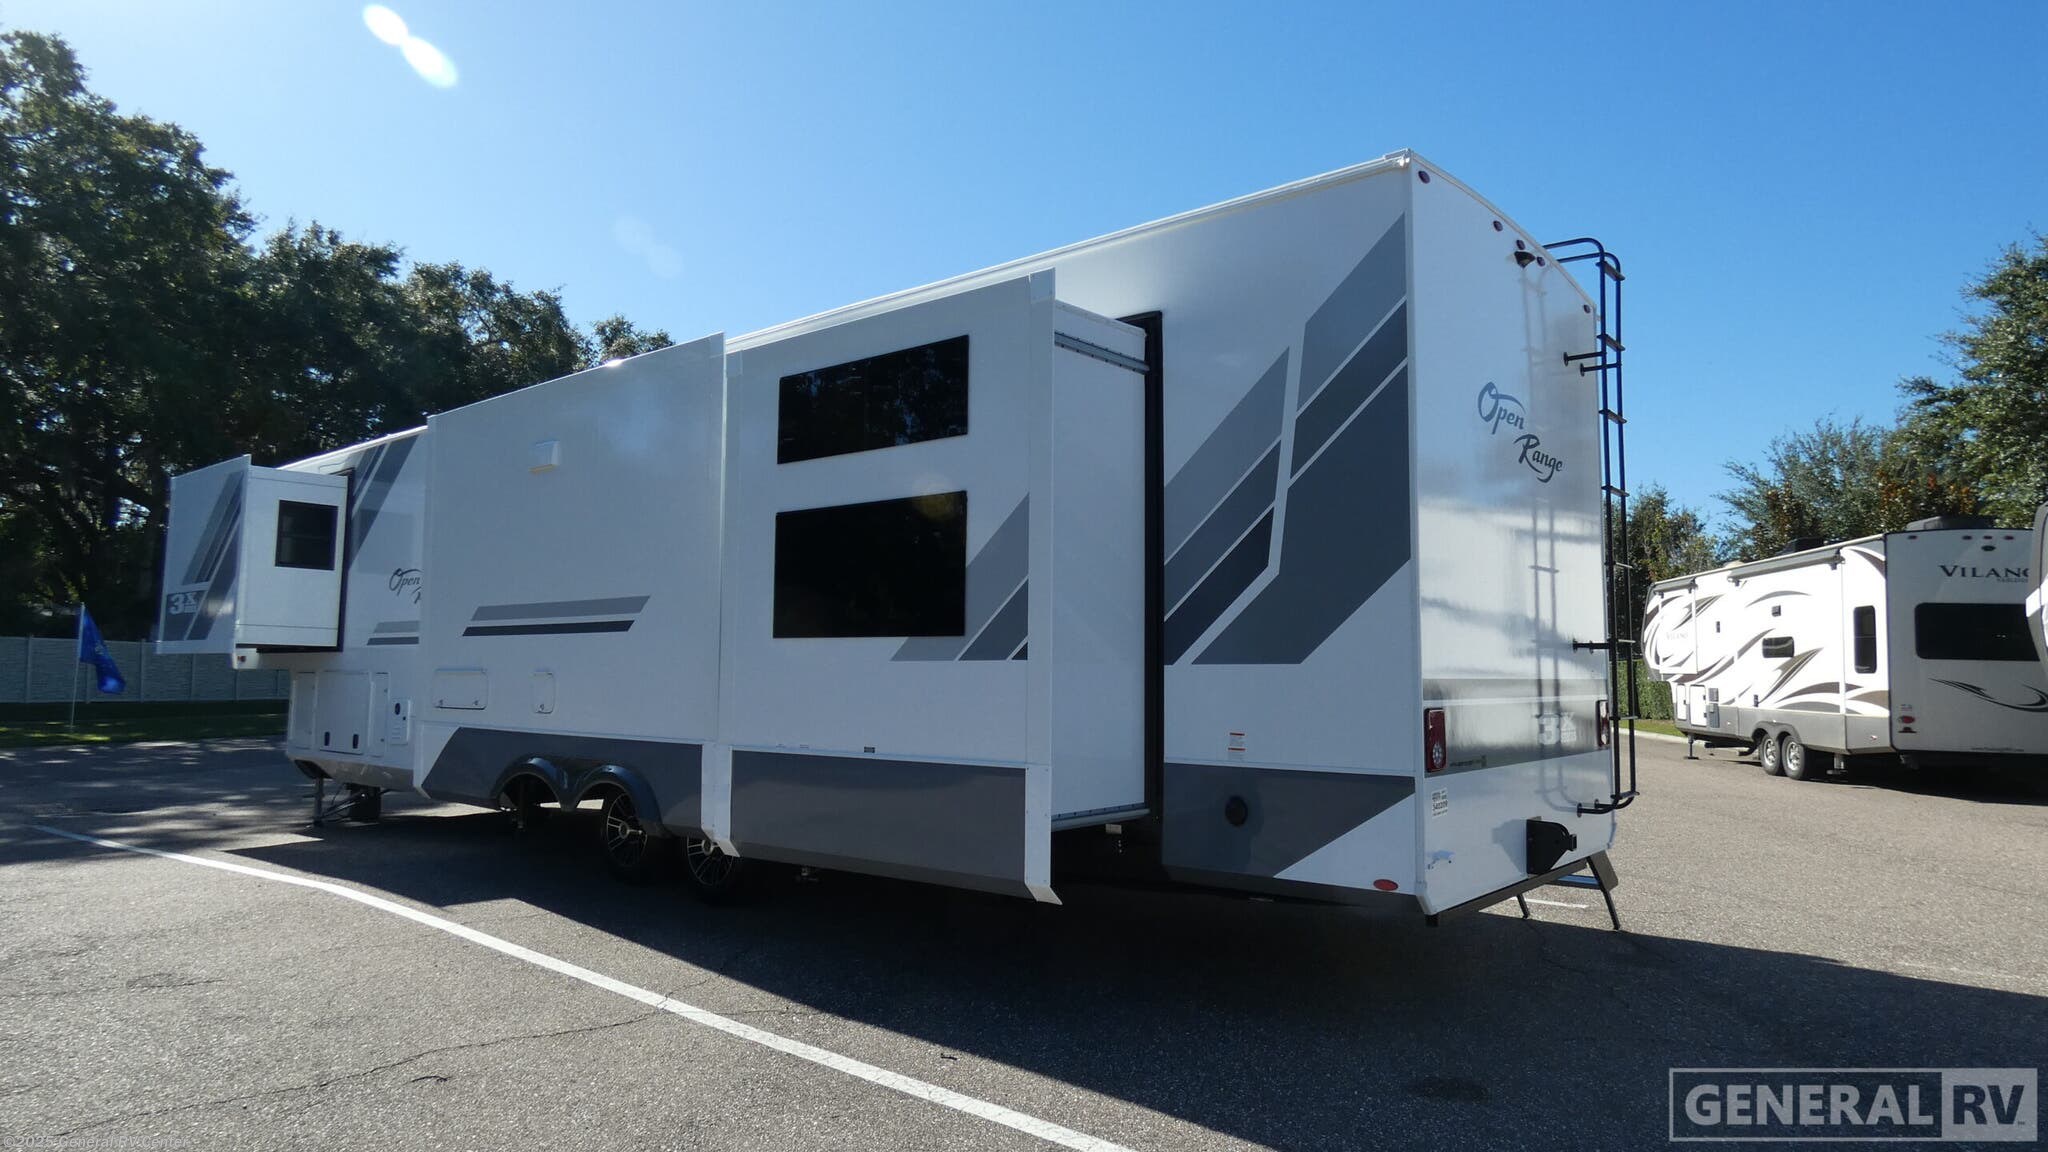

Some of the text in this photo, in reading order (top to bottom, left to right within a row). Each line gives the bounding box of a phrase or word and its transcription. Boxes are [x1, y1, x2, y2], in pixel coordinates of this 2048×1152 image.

[1478, 382, 1526, 435] Open
[1513, 434, 1563, 483] Range
[389, 568, 424, 597] Open
